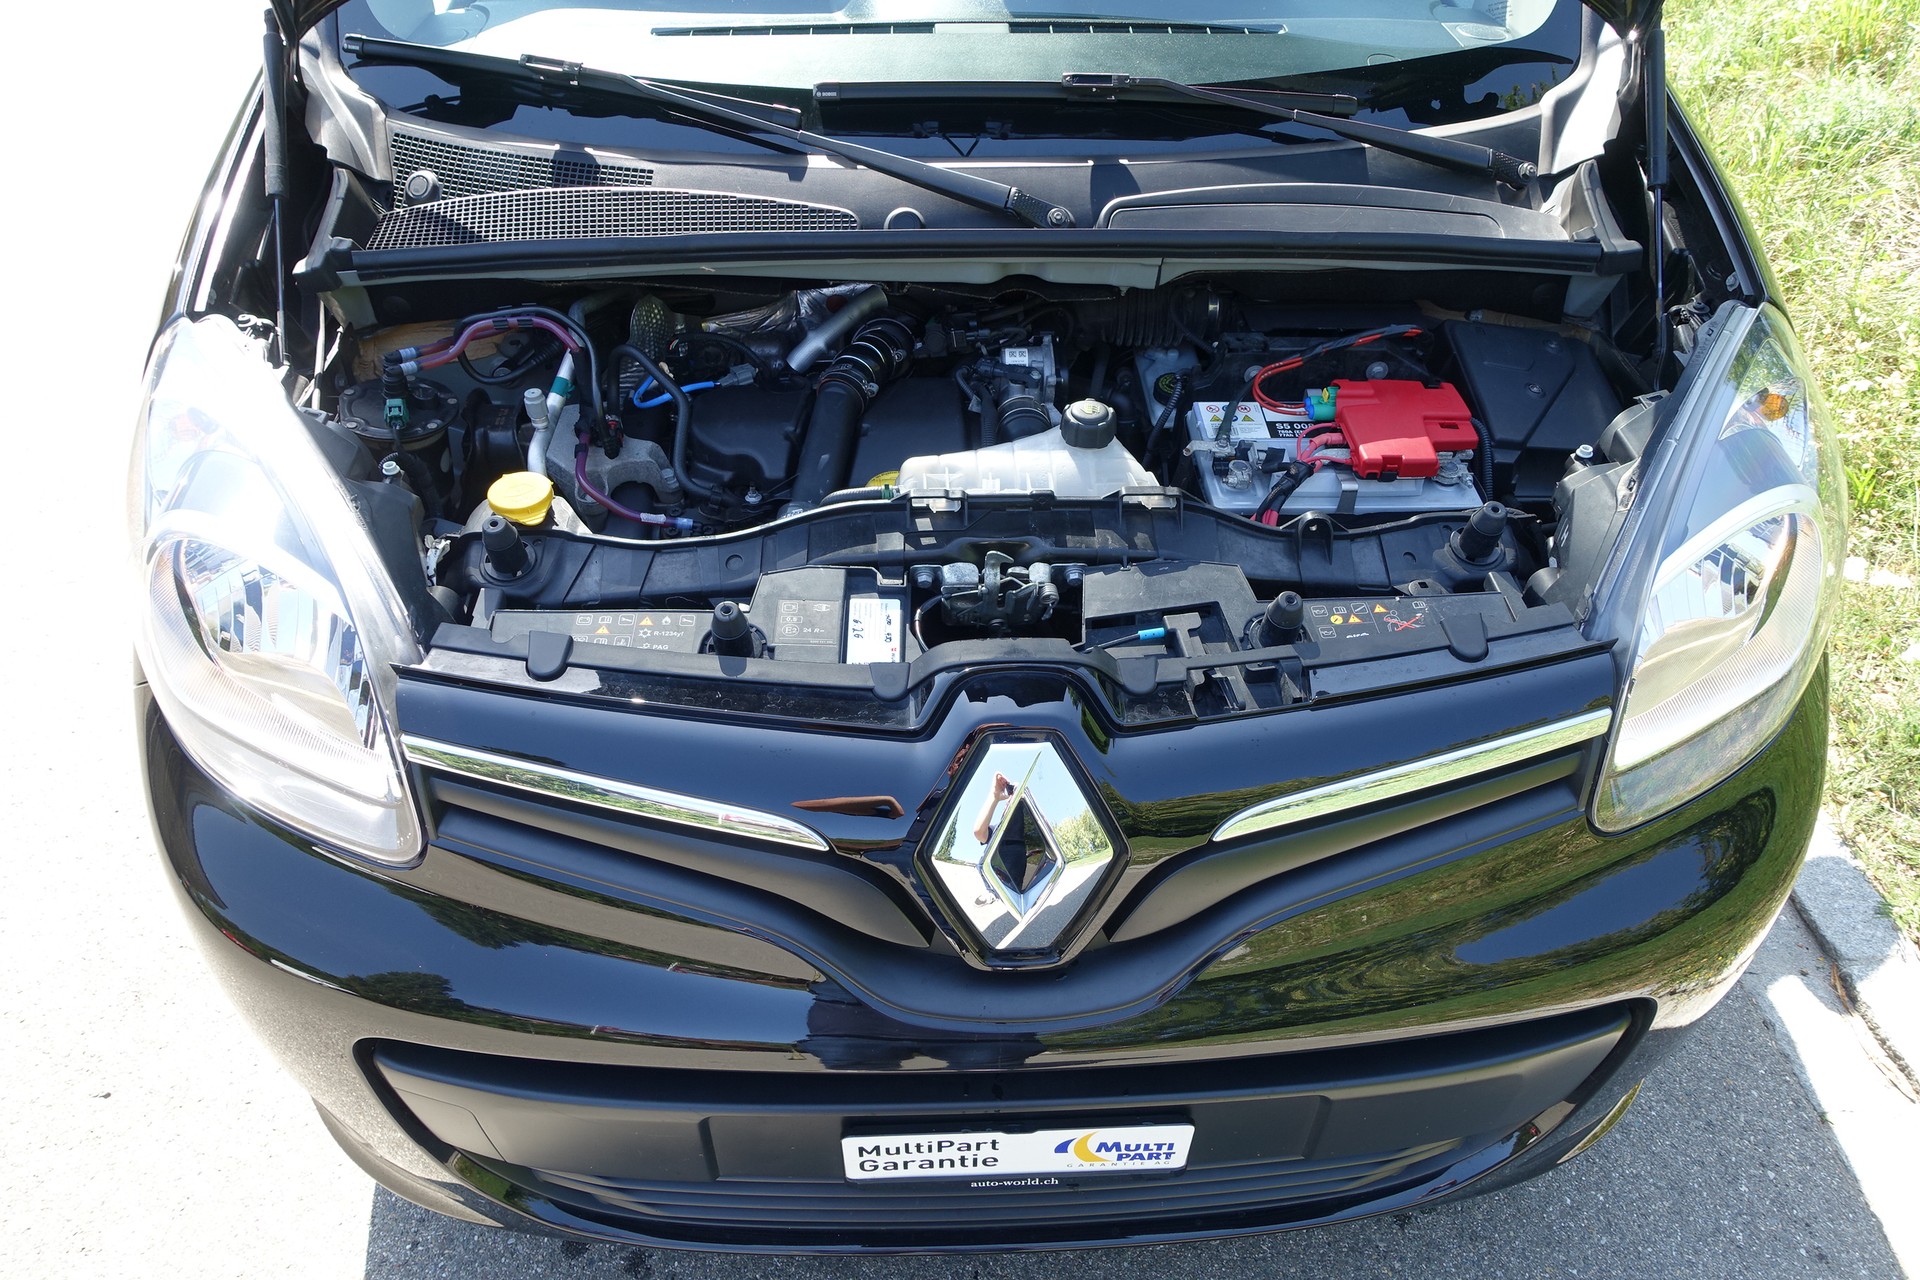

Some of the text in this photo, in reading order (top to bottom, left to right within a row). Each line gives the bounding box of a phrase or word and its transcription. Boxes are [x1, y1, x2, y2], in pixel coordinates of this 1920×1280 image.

[653, 630, 684, 638] R-1234yf
[857, 1139, 1000, 1158] MultiPart
[1116, 1151, 1176, 1162] PART
[858, 1154, 999, 1172] Garantie
[970, 1177, 1059, 1188] auto-world.ch
